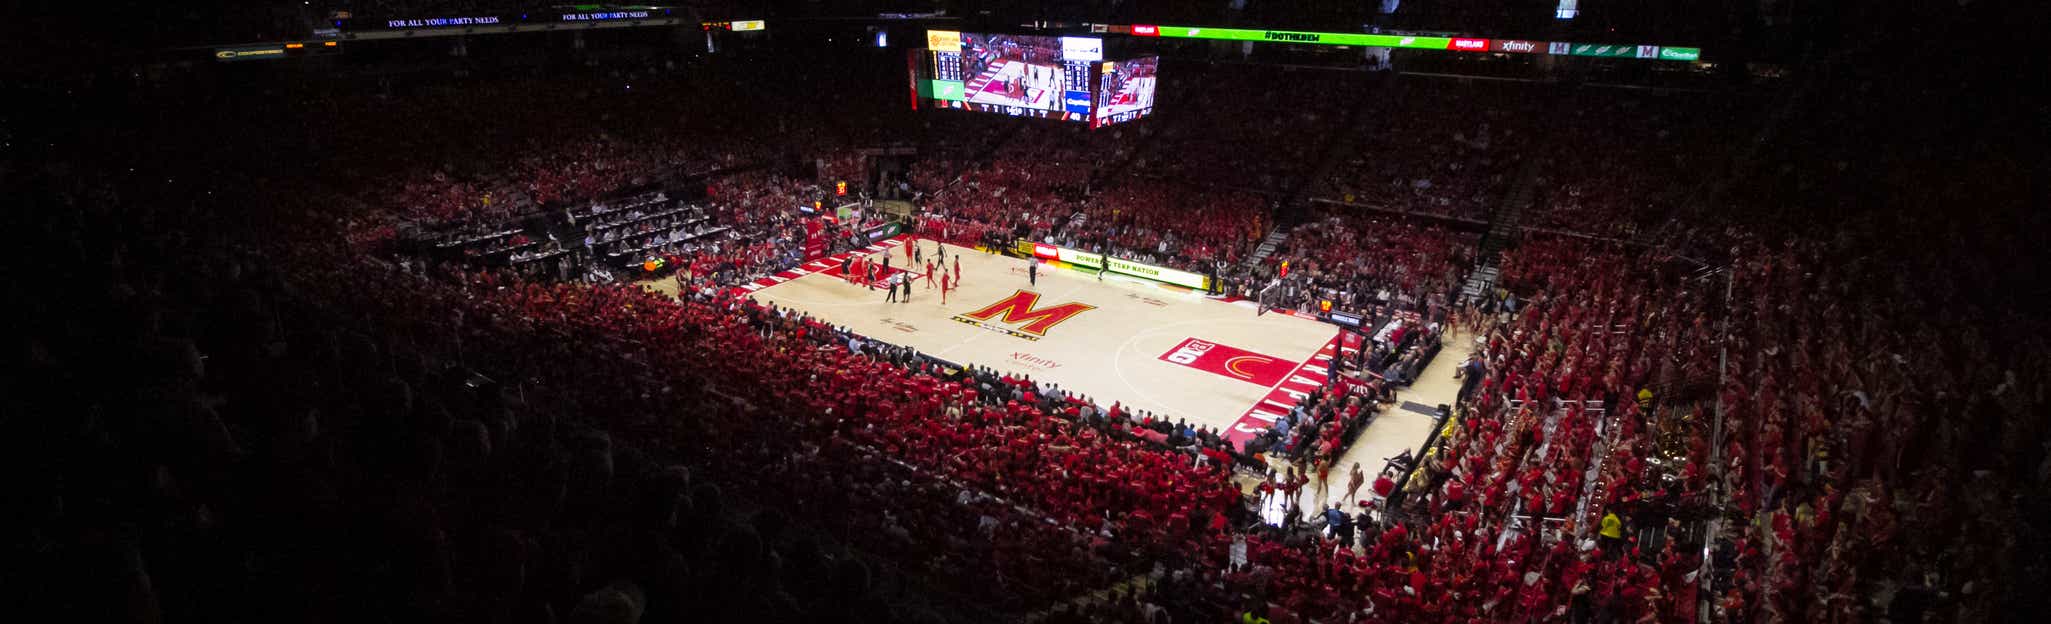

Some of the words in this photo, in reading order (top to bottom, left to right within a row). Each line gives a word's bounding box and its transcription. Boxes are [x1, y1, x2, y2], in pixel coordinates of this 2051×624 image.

[610, 11, 628, 19] PARTY
[629, 10, 648, 18] NEEDS
[388, 20, 406, 28] FOR
[408, 19, 423, 27] ALL
[425, 18, 447, 26] YOUR
[449, 17, 473, 25] PARTY
[475, 16, 500, 24] NEEDS
[1502, 41, 1536, 52] xfinity
[1132, 265, 1160, 276] NATION
